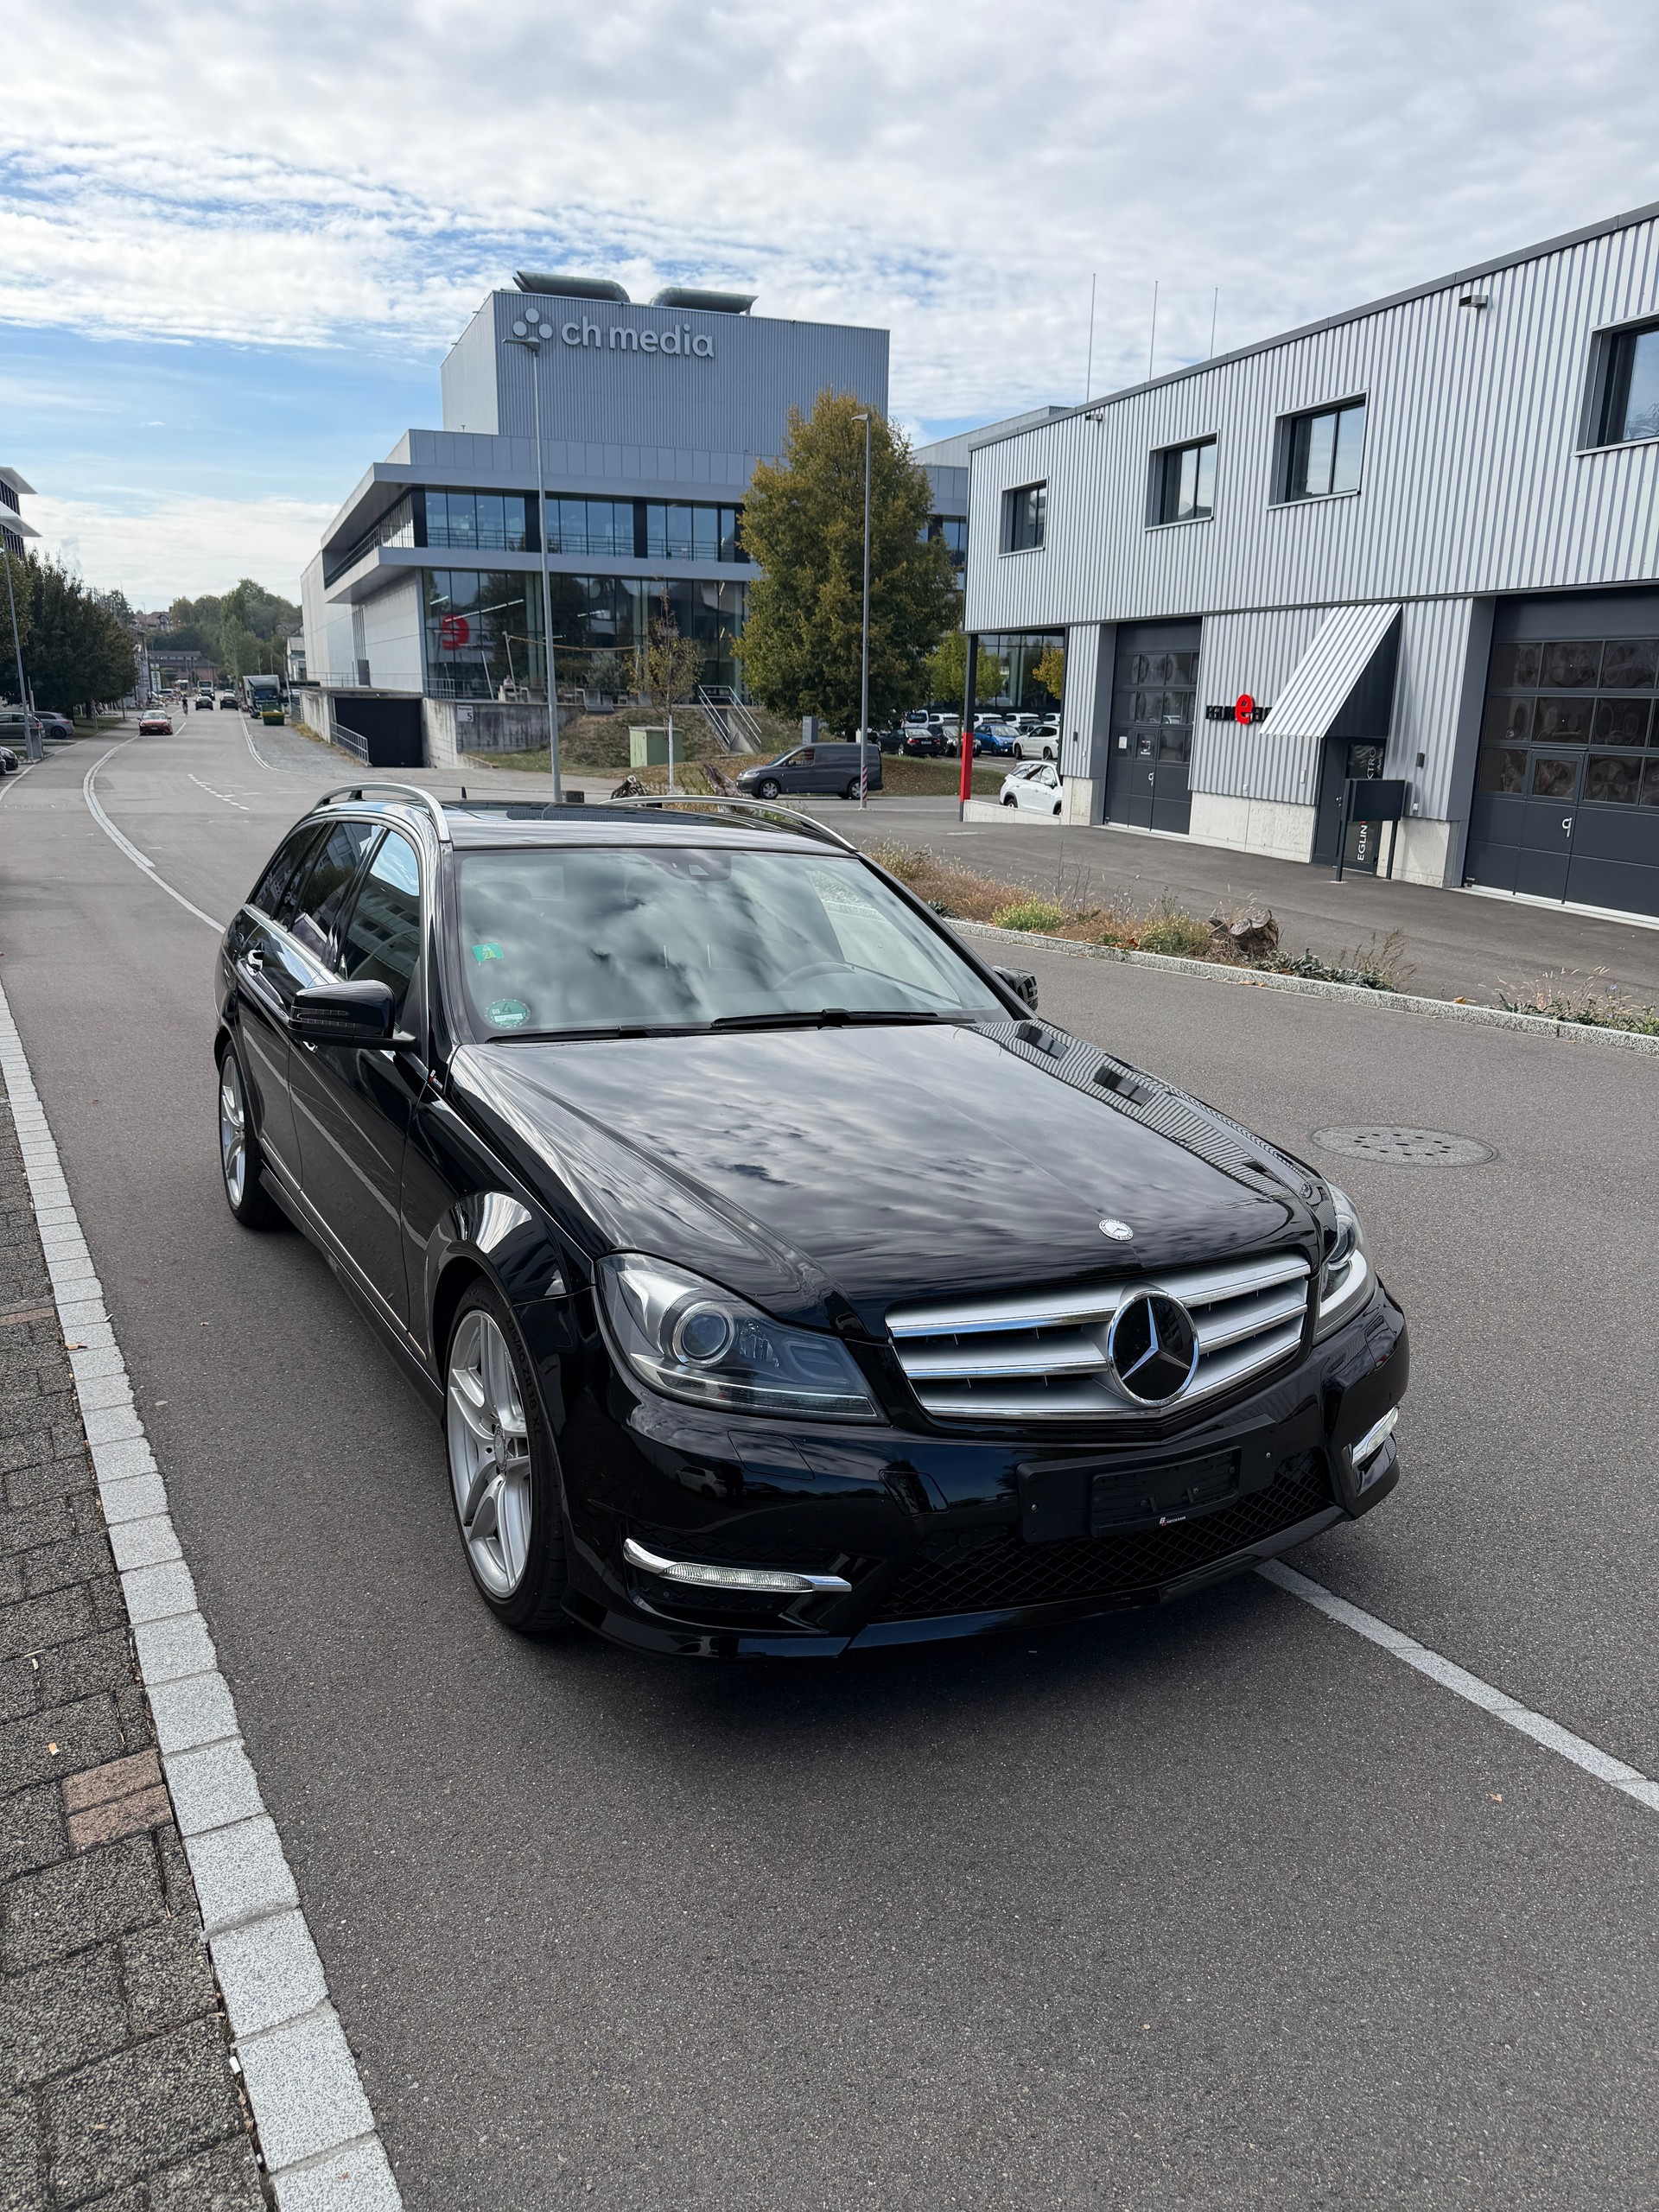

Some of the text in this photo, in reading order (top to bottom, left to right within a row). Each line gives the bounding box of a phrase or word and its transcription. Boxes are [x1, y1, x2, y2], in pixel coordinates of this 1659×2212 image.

[562, 316, 715, 359] ch media
[467, 712, 473, 721] 5
[1357, 824, 1368, 861] EGLIN
[501, 1002, 512, 1014] 4
[505, 1315, 526, 1364] 225/40
